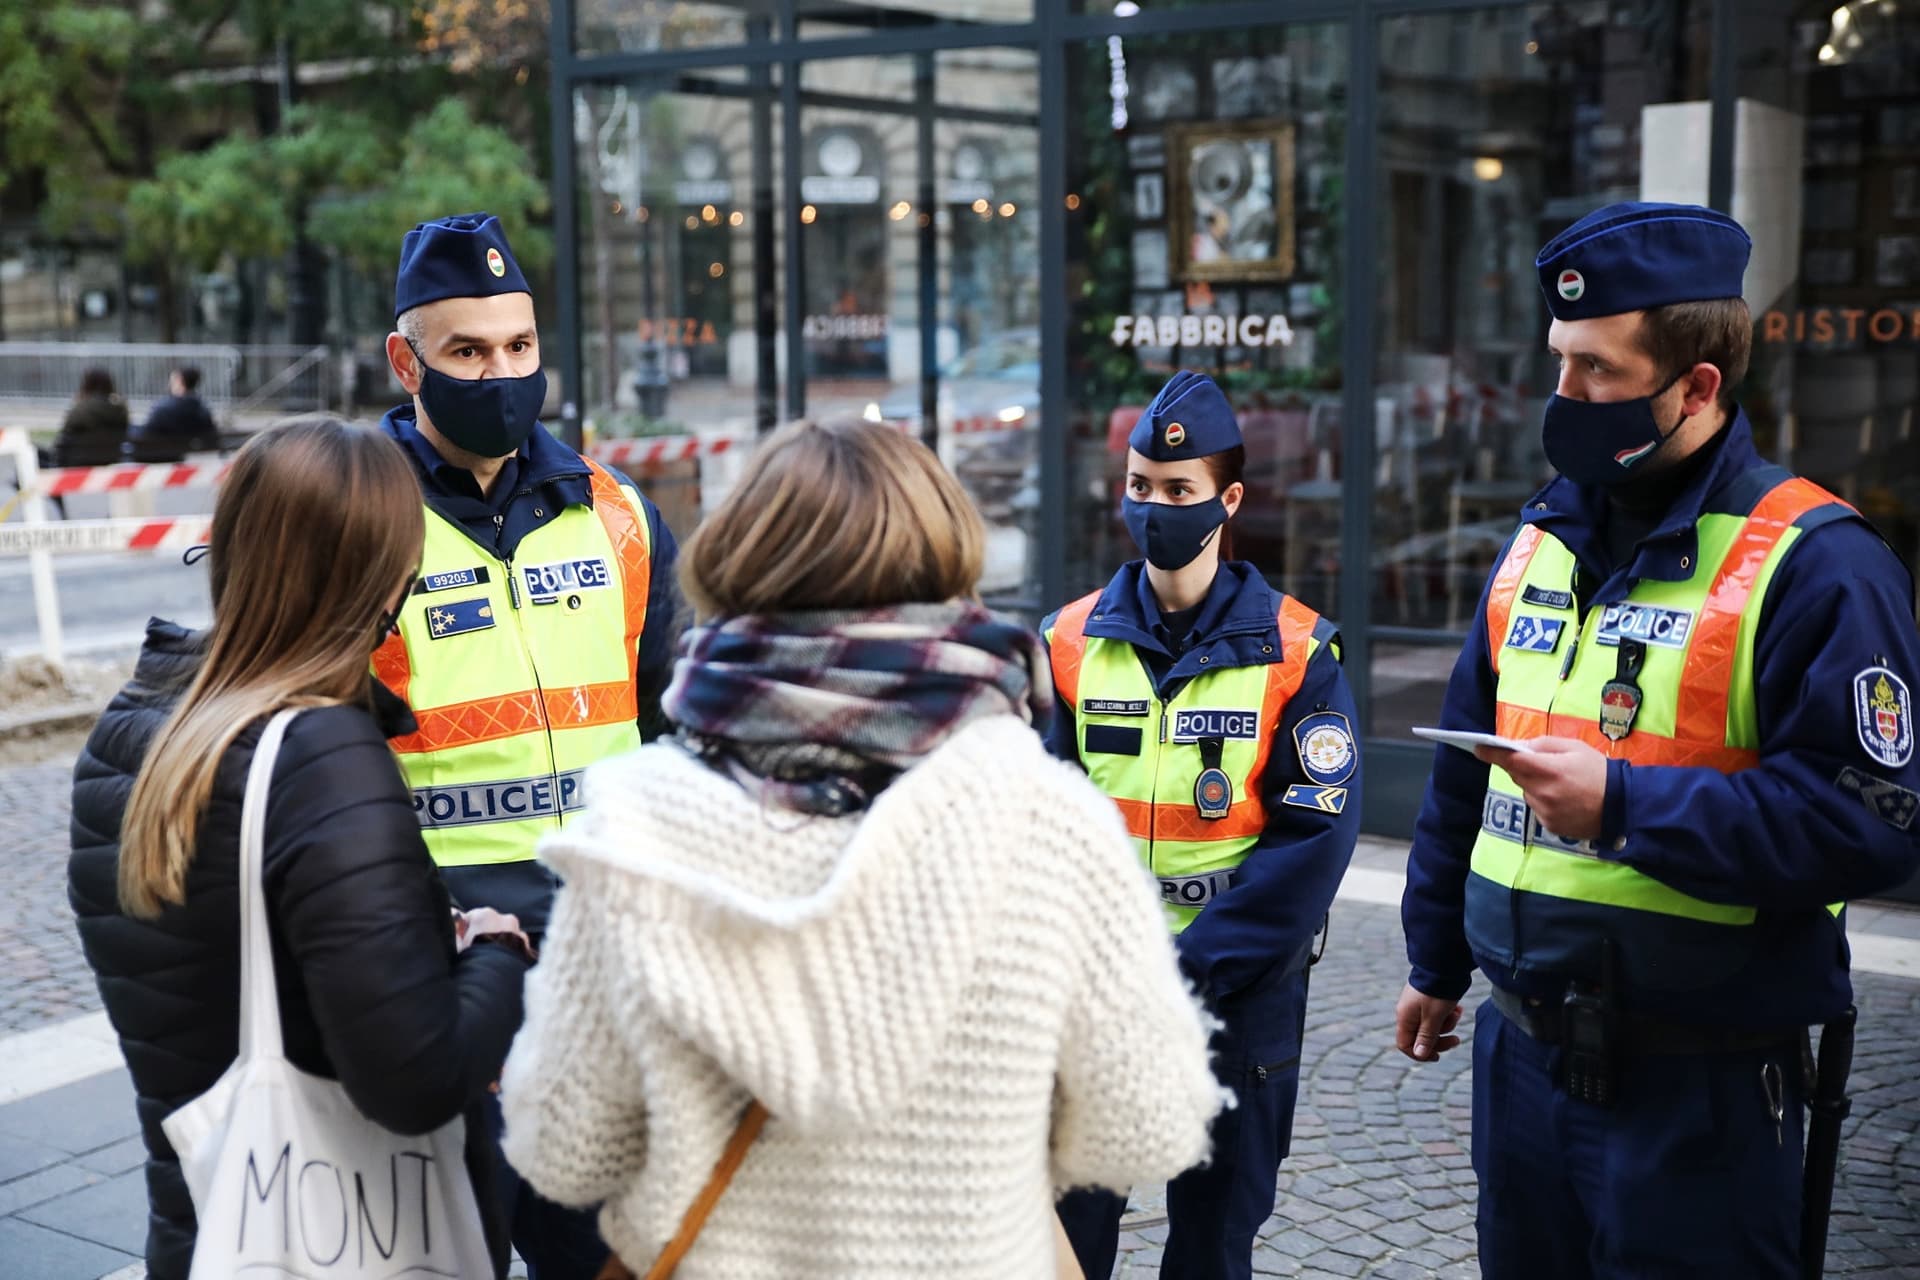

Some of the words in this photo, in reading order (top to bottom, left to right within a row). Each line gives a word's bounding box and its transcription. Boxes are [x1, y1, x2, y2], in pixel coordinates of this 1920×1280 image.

[1111, 314, 1295, 347] FABBRICA
[433, 572, 468, 587] 99205
[526, 562, 609, 593] POLICE
[1601, 607, 1689, 641] POLICE
[1870, 698, 1901, 714] POLICE
[1177, 714, 1256, 736] POLICE
[237, 1141, 435, 1270] MONT
